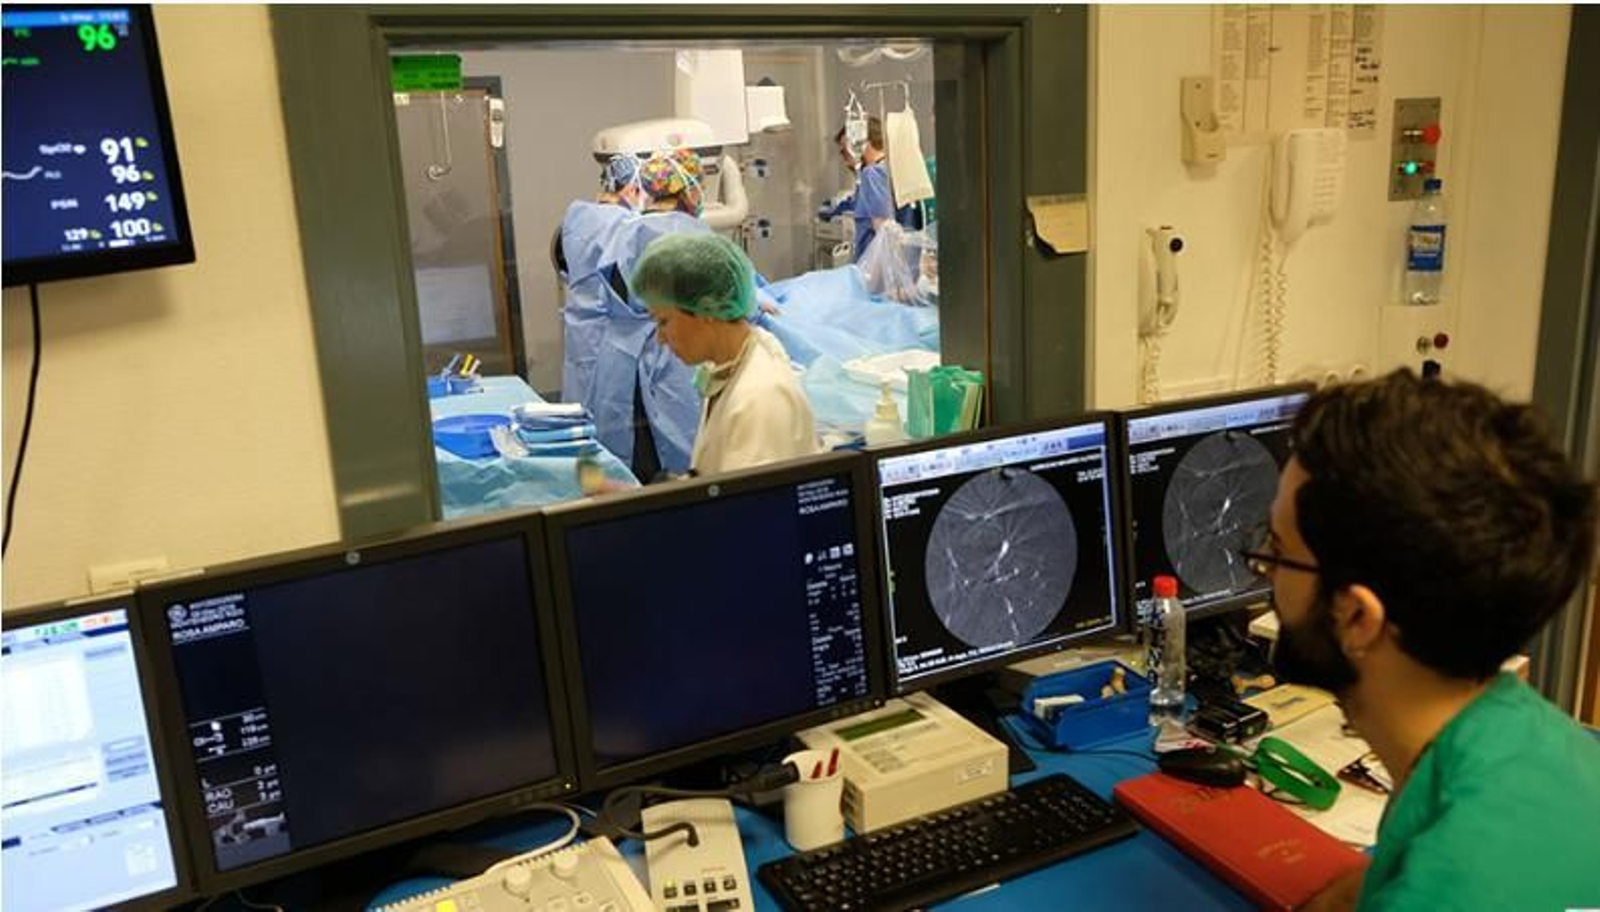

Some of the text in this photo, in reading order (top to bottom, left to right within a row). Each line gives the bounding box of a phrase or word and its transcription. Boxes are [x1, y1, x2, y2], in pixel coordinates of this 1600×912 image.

[77, 23, 117, 51] 96
[100, 137, 135, 164] 91
[110, 164, 141, 184] 96
[104, 191, 146, 213] 149
[109, 217, 151, 239] 100
[204, 787, 233, 803] RAO
[207, 798, 235, 814] CAU
